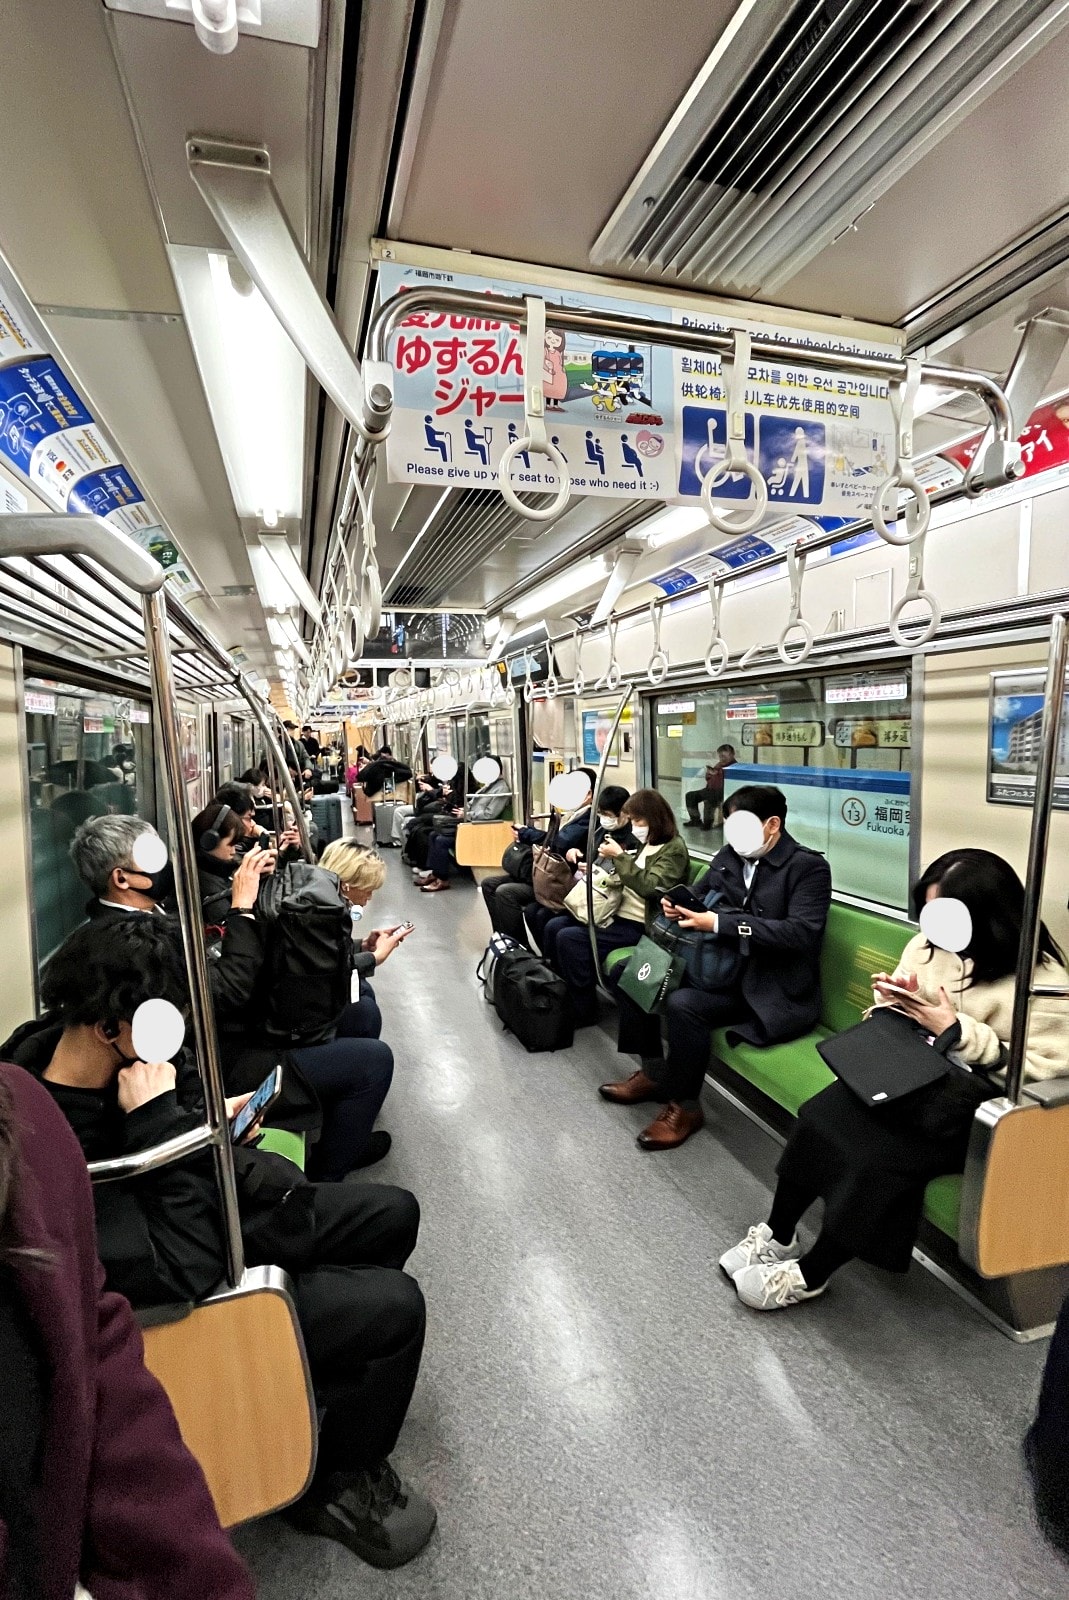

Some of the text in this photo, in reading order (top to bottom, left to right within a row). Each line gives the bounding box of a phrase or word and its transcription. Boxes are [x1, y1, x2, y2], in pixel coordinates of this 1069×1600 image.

[385, 250, 392, 258] 2
[747, 366, 782, 385] 모차를
[786, 372, 809, 389] 위한
[813, 376, 833, 393] 우선
[837, 380, 890, 400] 공간입니다
[406, 463, 444, 475] Please
[447, 467, 470, 478] give
[474, 471, 487, 480] up
[491, 471, 515, 481] yr
[518, 472, 541, 483] seat
[544, 474, 555, 484] to
[589, 478, 610, 488] who
[612, 480, 636, 490] need
[639, 481, 647, 490] it
[851, 801, 857, 809] K
[847, 810, 860, 821] 13
[866, 822, 905, 836] Fukuoka
